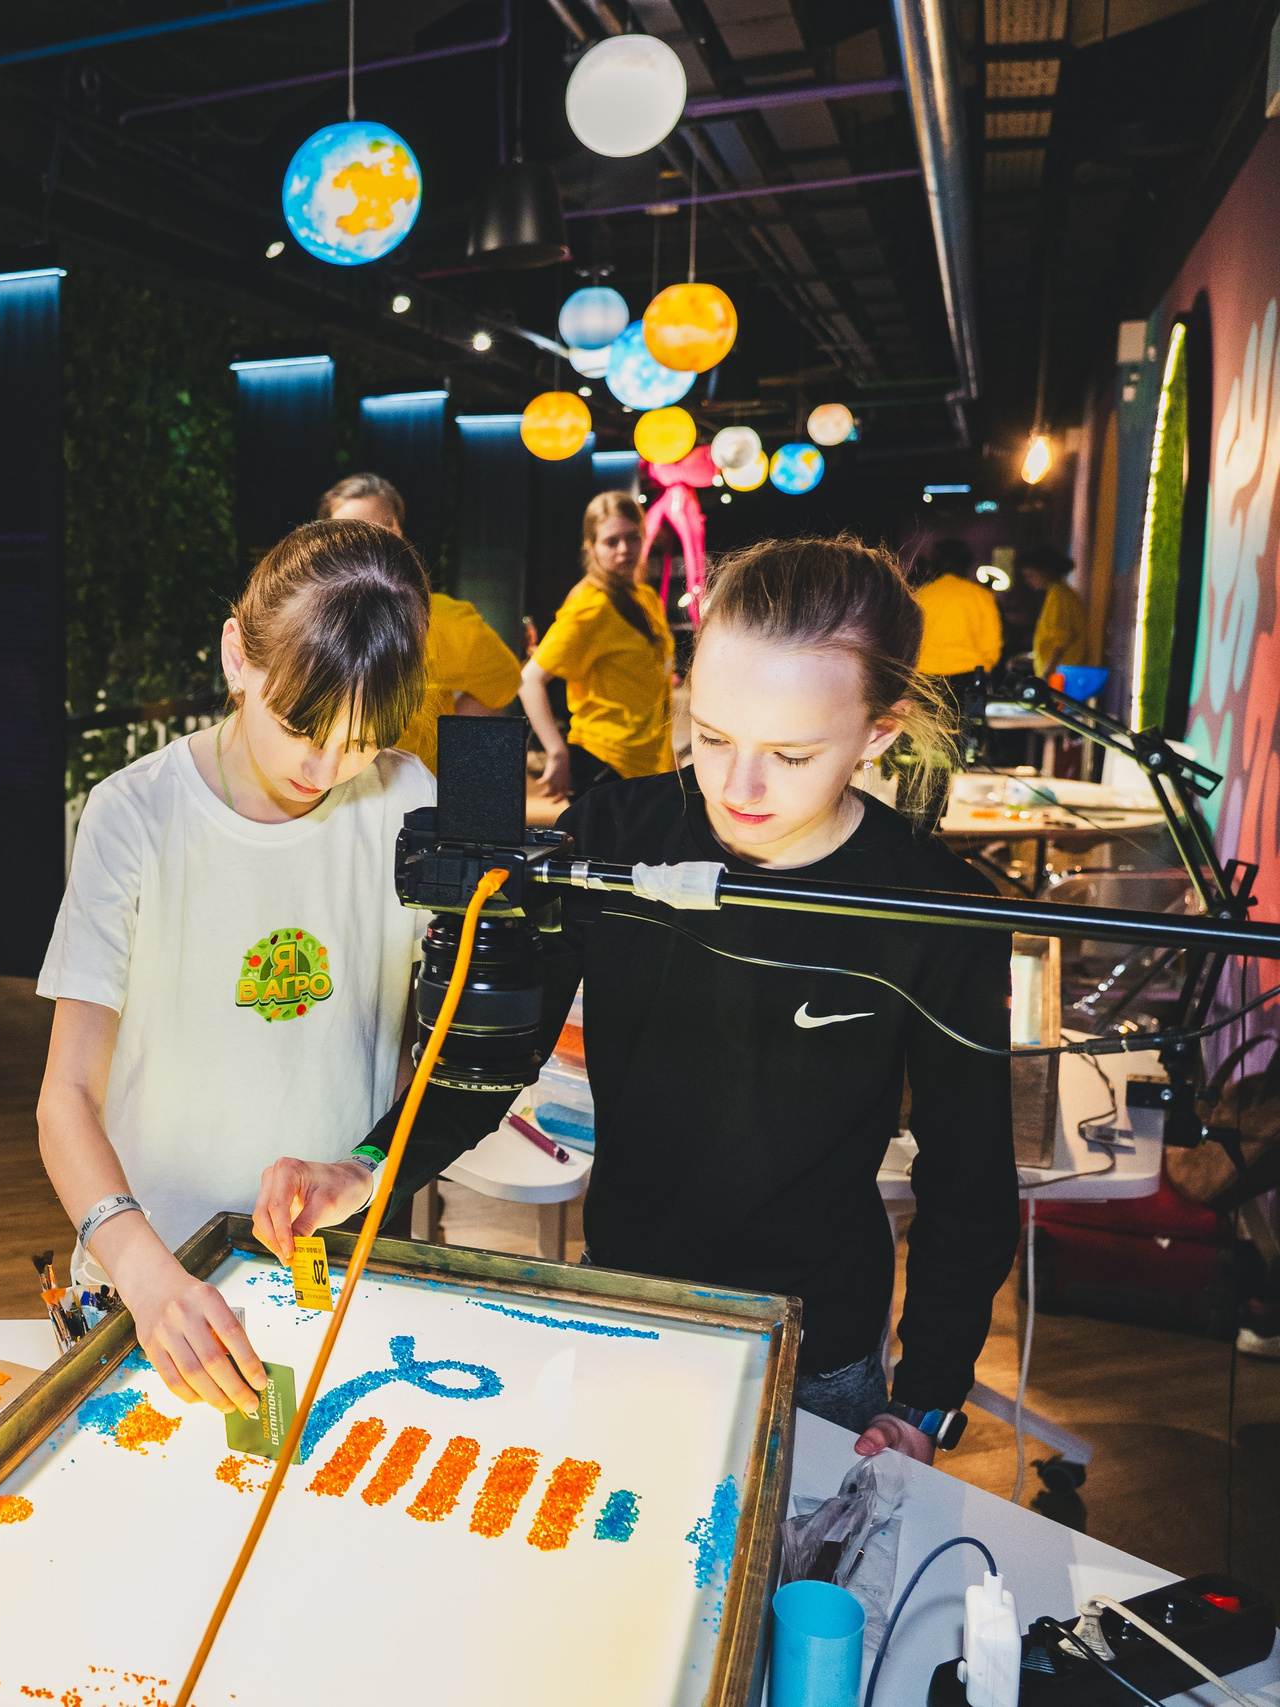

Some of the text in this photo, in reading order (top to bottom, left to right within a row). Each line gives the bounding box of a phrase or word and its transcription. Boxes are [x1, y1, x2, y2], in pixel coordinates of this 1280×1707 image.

[274, 944, 296, 976] Я
[240, 974, 330, 1001] В АГРО
